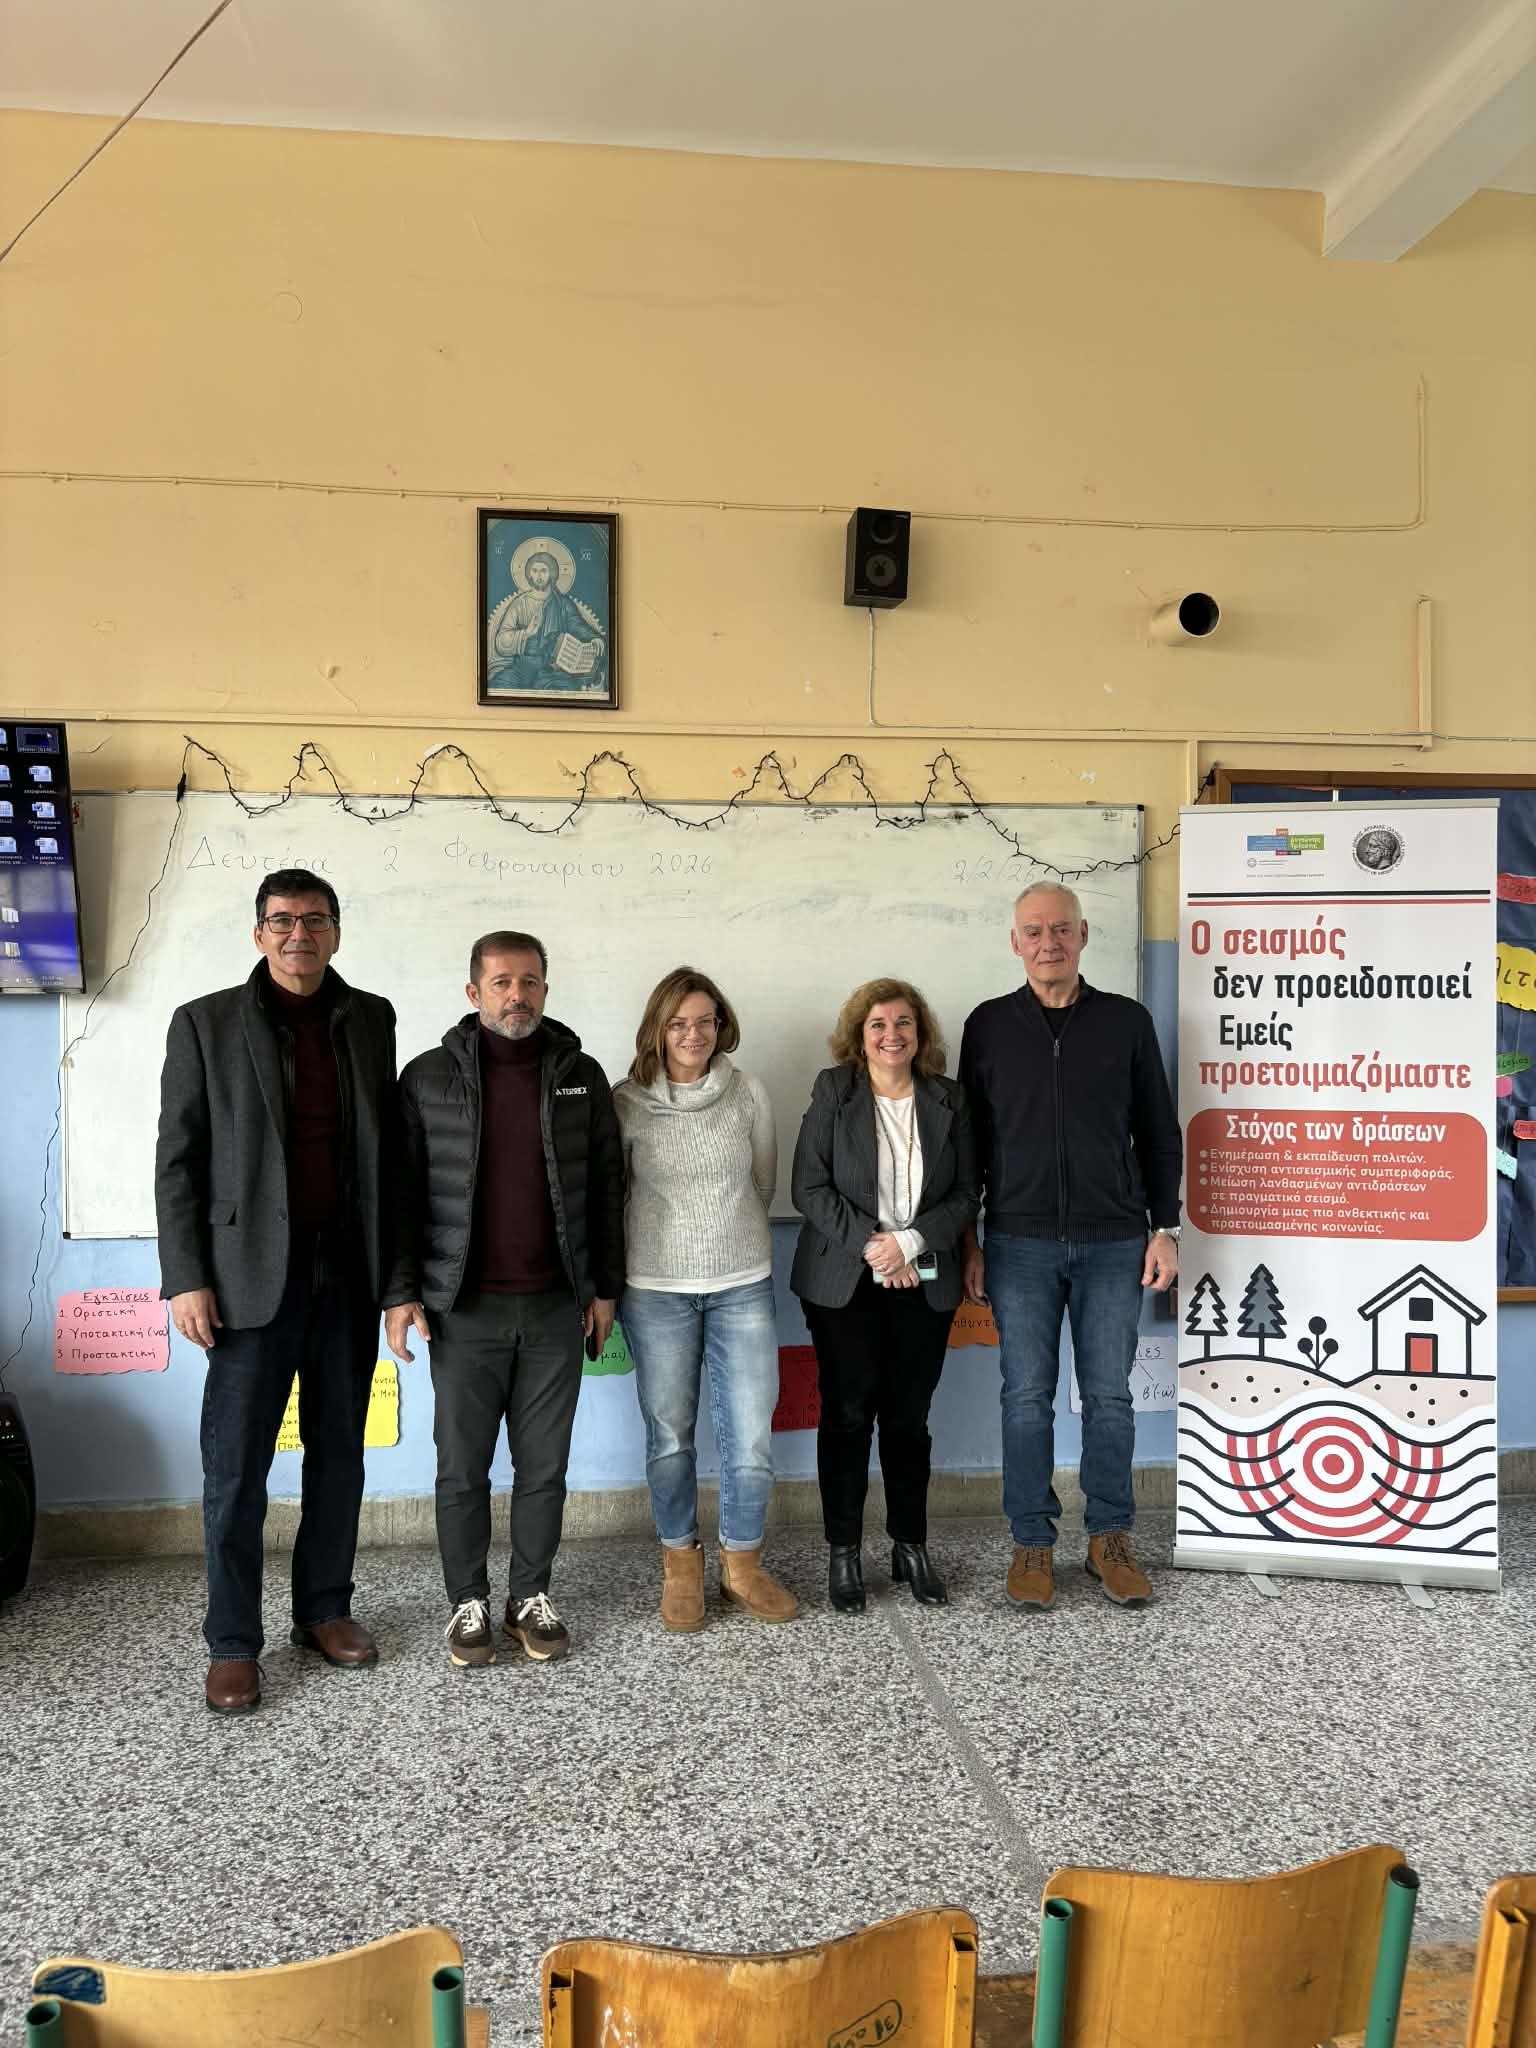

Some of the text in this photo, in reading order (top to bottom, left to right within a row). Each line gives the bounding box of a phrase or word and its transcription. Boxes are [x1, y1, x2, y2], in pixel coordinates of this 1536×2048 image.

[384, 846, 398, 873] 2
[650, 852, 713, 874] 2026
[1192, 915, 1346, 960] Ο σεισμός
[1214, 962, 1472, 1007] δεν προειδοποιεί
[1220, 1011, 1293, 1050] Εμείς
[1200, 1051, 1471, 1093] προετοιμαζόμαστε
[1226, 1112, 1446, 1147] Στόχος των δράσεων
[1210, 1148, 1426, 1164] Ενημέρωση & εκπαίδευση πολιτών.
[1210, 1162, 1455, 1180] Ενίσχυση αντισεισμικής συμπεριφοράς.
[1210, 1176, 1427, 1192] Μείωση λανθασμένων αντιδράσεων
[1211, 1191, 1350, 1205] σε πραγματικό σεισμό.
[1210, 1203, 1279, 1217] Δημιουργία
[1282, 1209, 1309, 1218] μιας
[1337, 1208, 1406, 1221] ανθεκτικής
[1409, 1211, 1430, 1220] και
[1211, 1219, 1385, 1234] προετοιμασμένης κοινωνίας.
[73, 1305, 137, 1321] Οριστική
[69, 1327, 144, 1339] Υποτακτική
[71, 1348, 156, 1362] Προστακτική
